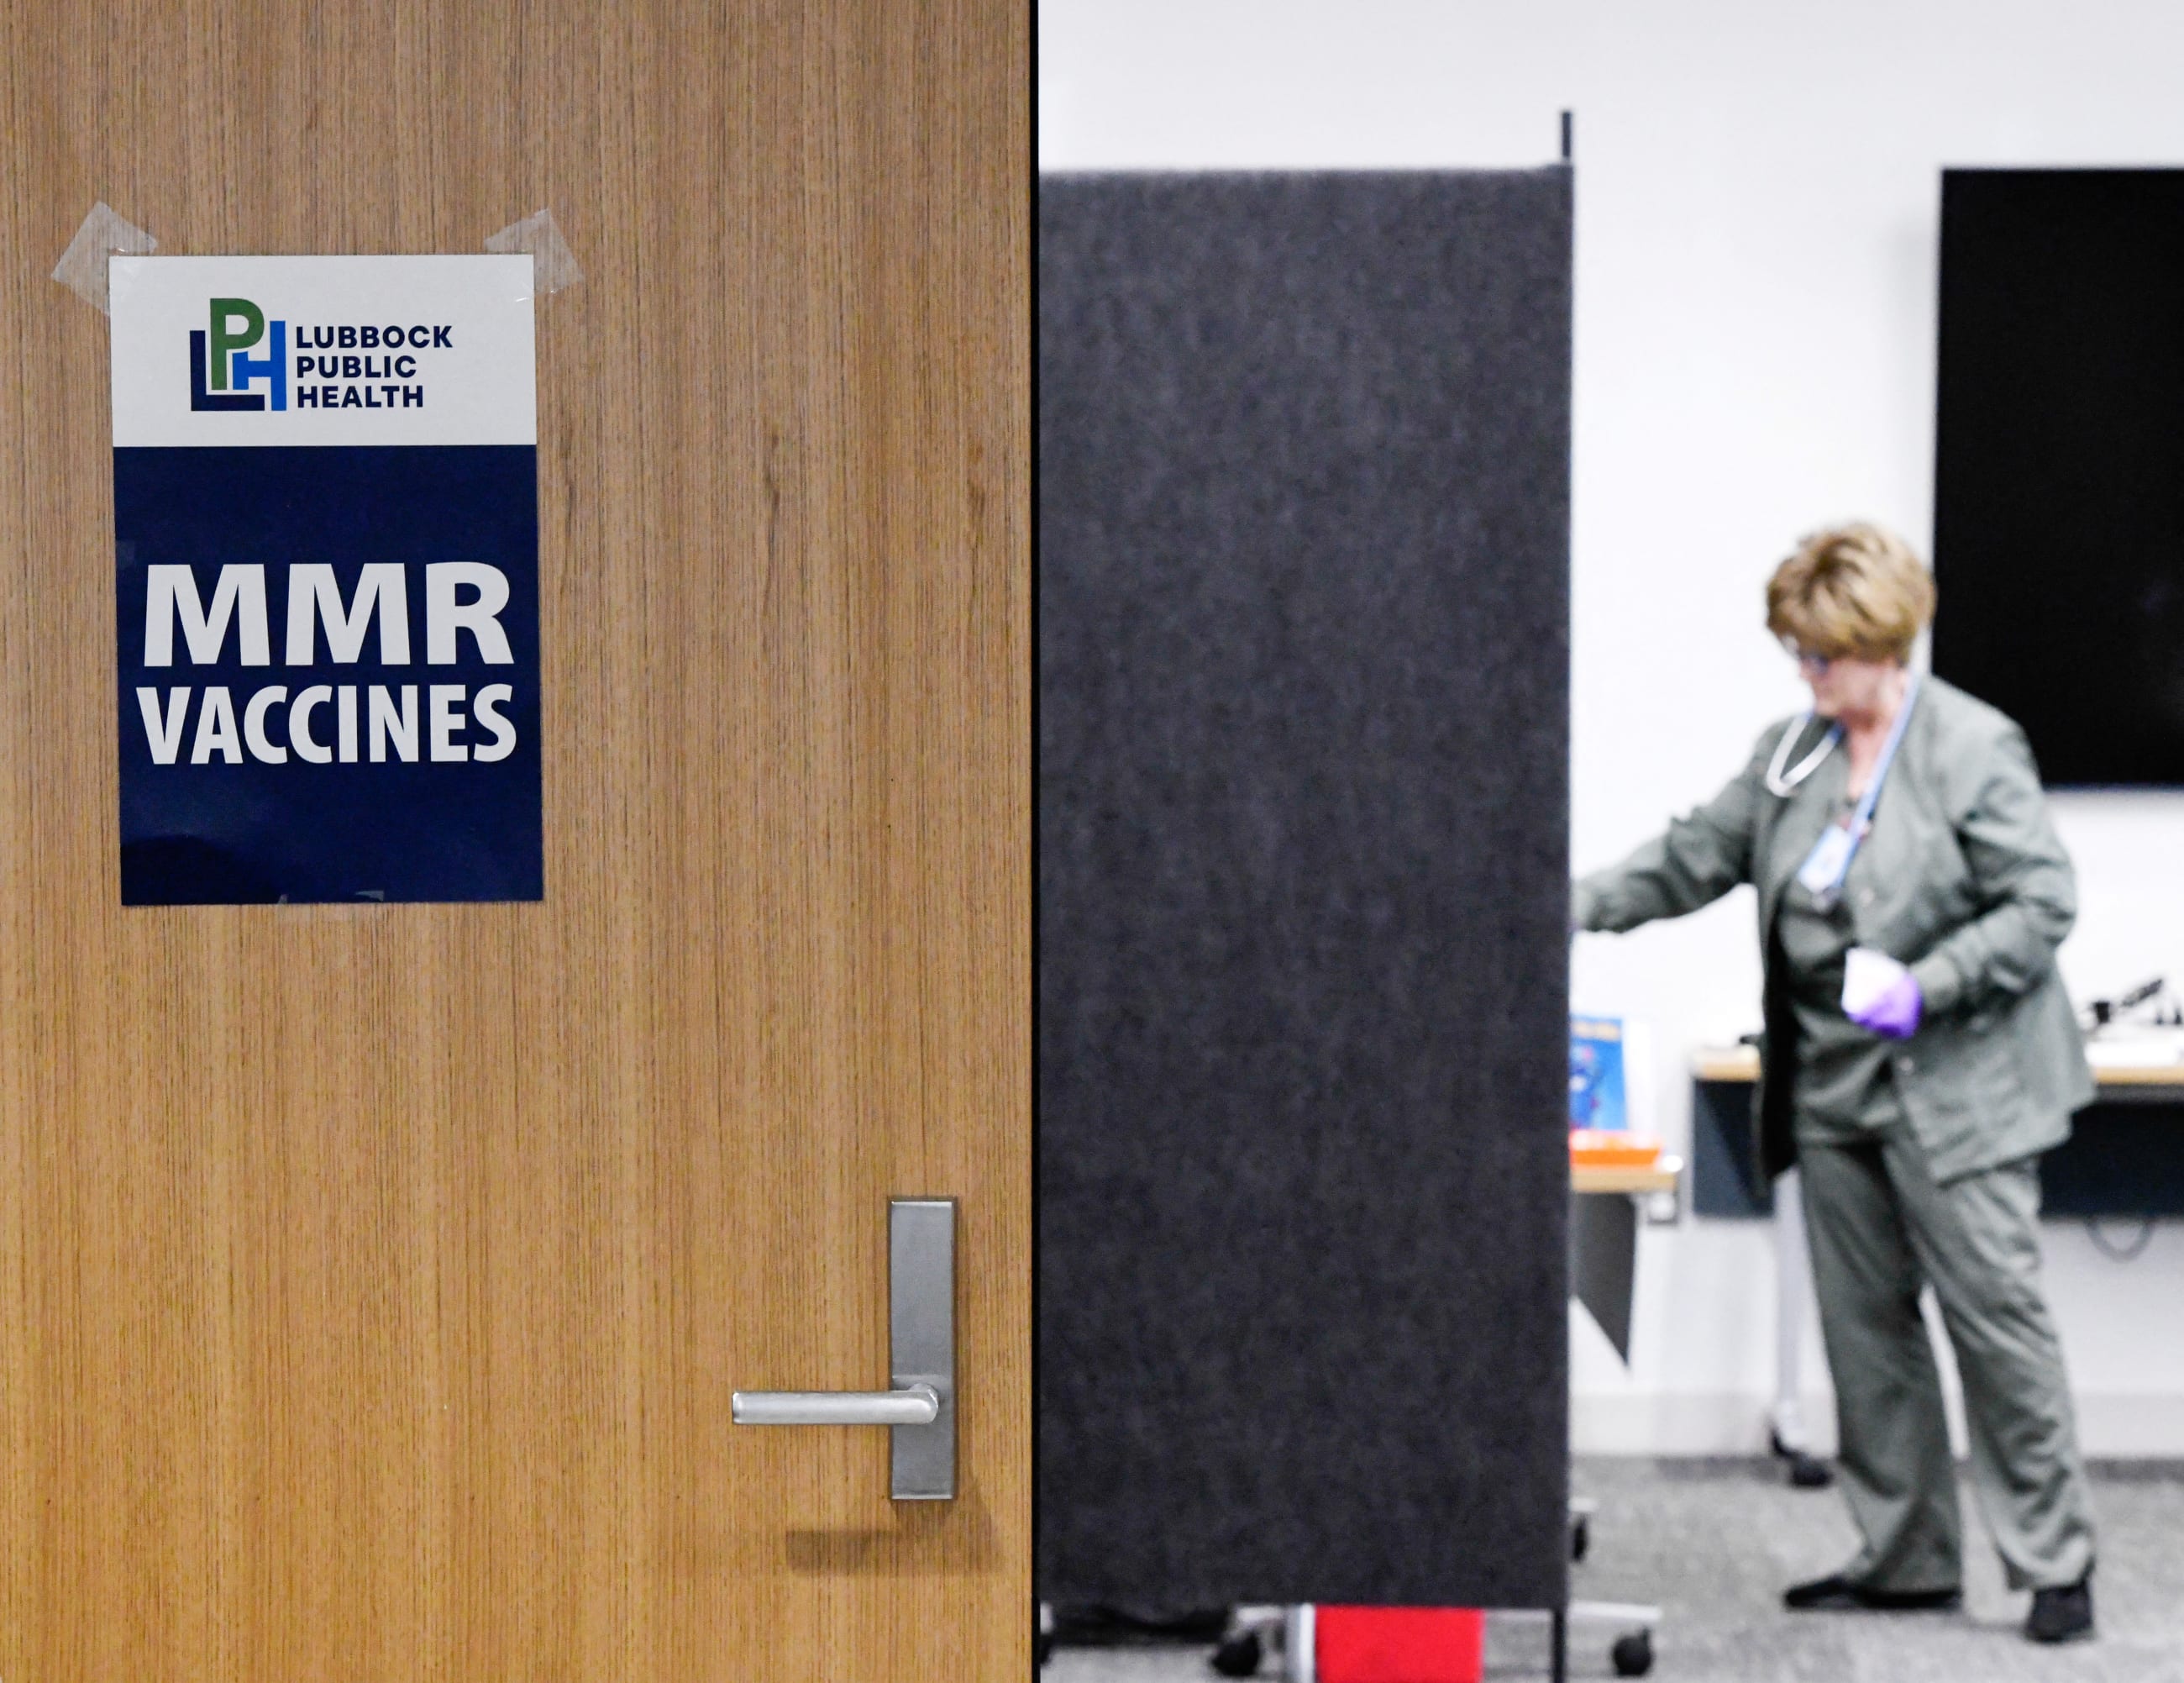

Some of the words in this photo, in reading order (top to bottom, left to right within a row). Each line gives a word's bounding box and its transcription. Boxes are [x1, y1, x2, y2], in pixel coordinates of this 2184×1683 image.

[190, 298, 286, 411] LPH
[297, 325, 453, 349] LUBBOCK
[297, 355, 416, 378] PUBLIC
[297, 386, 423, 408] HEALTH
[144, 562, 513, 666] MMR
[136, 684, 516, 764] VACCINES
